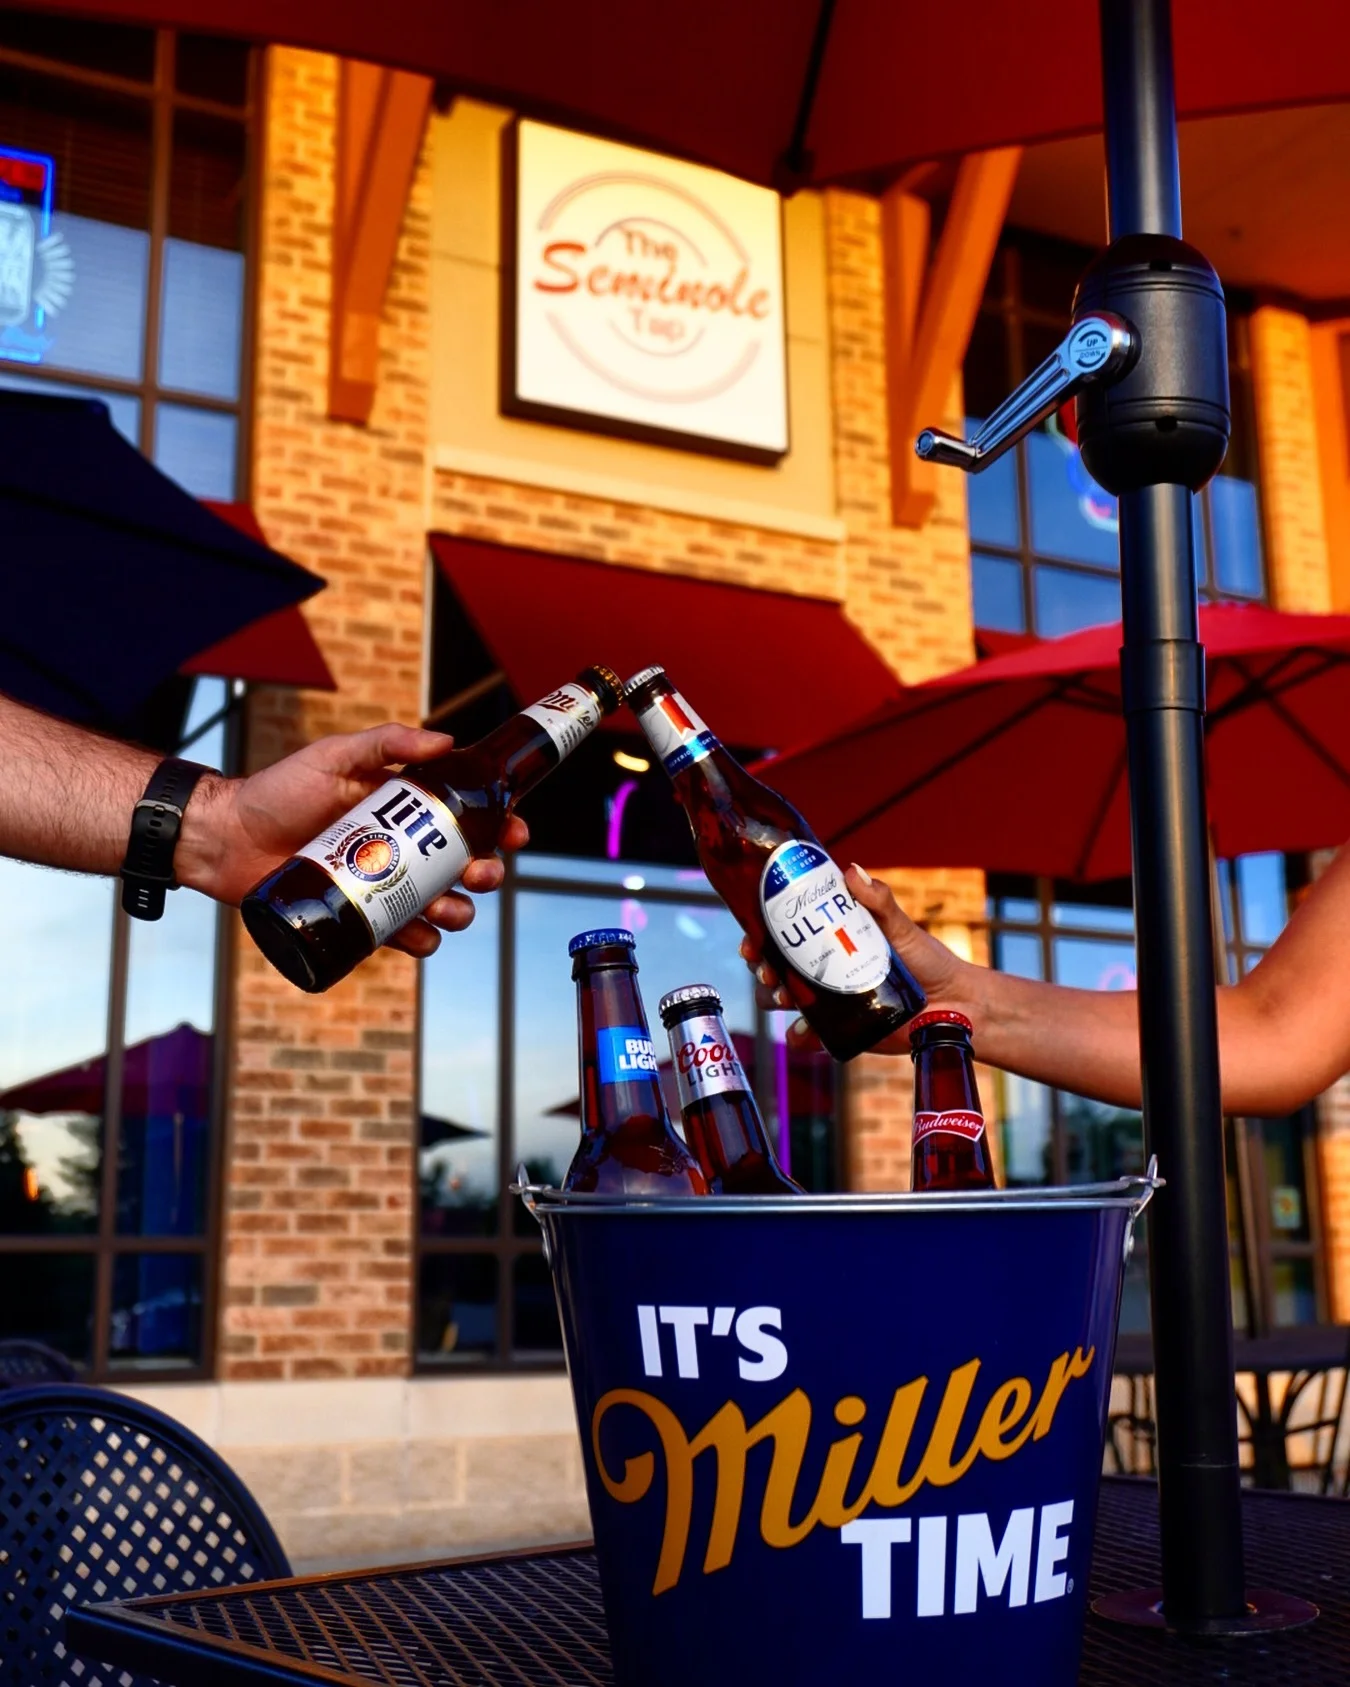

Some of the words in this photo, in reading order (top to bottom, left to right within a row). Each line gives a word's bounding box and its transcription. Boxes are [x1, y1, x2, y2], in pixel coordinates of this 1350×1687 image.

[533, 242, 770, 320] Seminole
[1086, 339, 1098, 347] UP
[370, 787, 448, 858] Lite
[785, 873, 838, 919] Michelob
[799, 854, 817, 869] BEER
[914, 1115, 982, 1136] Budweiser
[637, 1304, 788, 1382] IT'S
[591, 1346, 1095, 1597] Miller
[841, 1500, 1074, 1619] TIME
